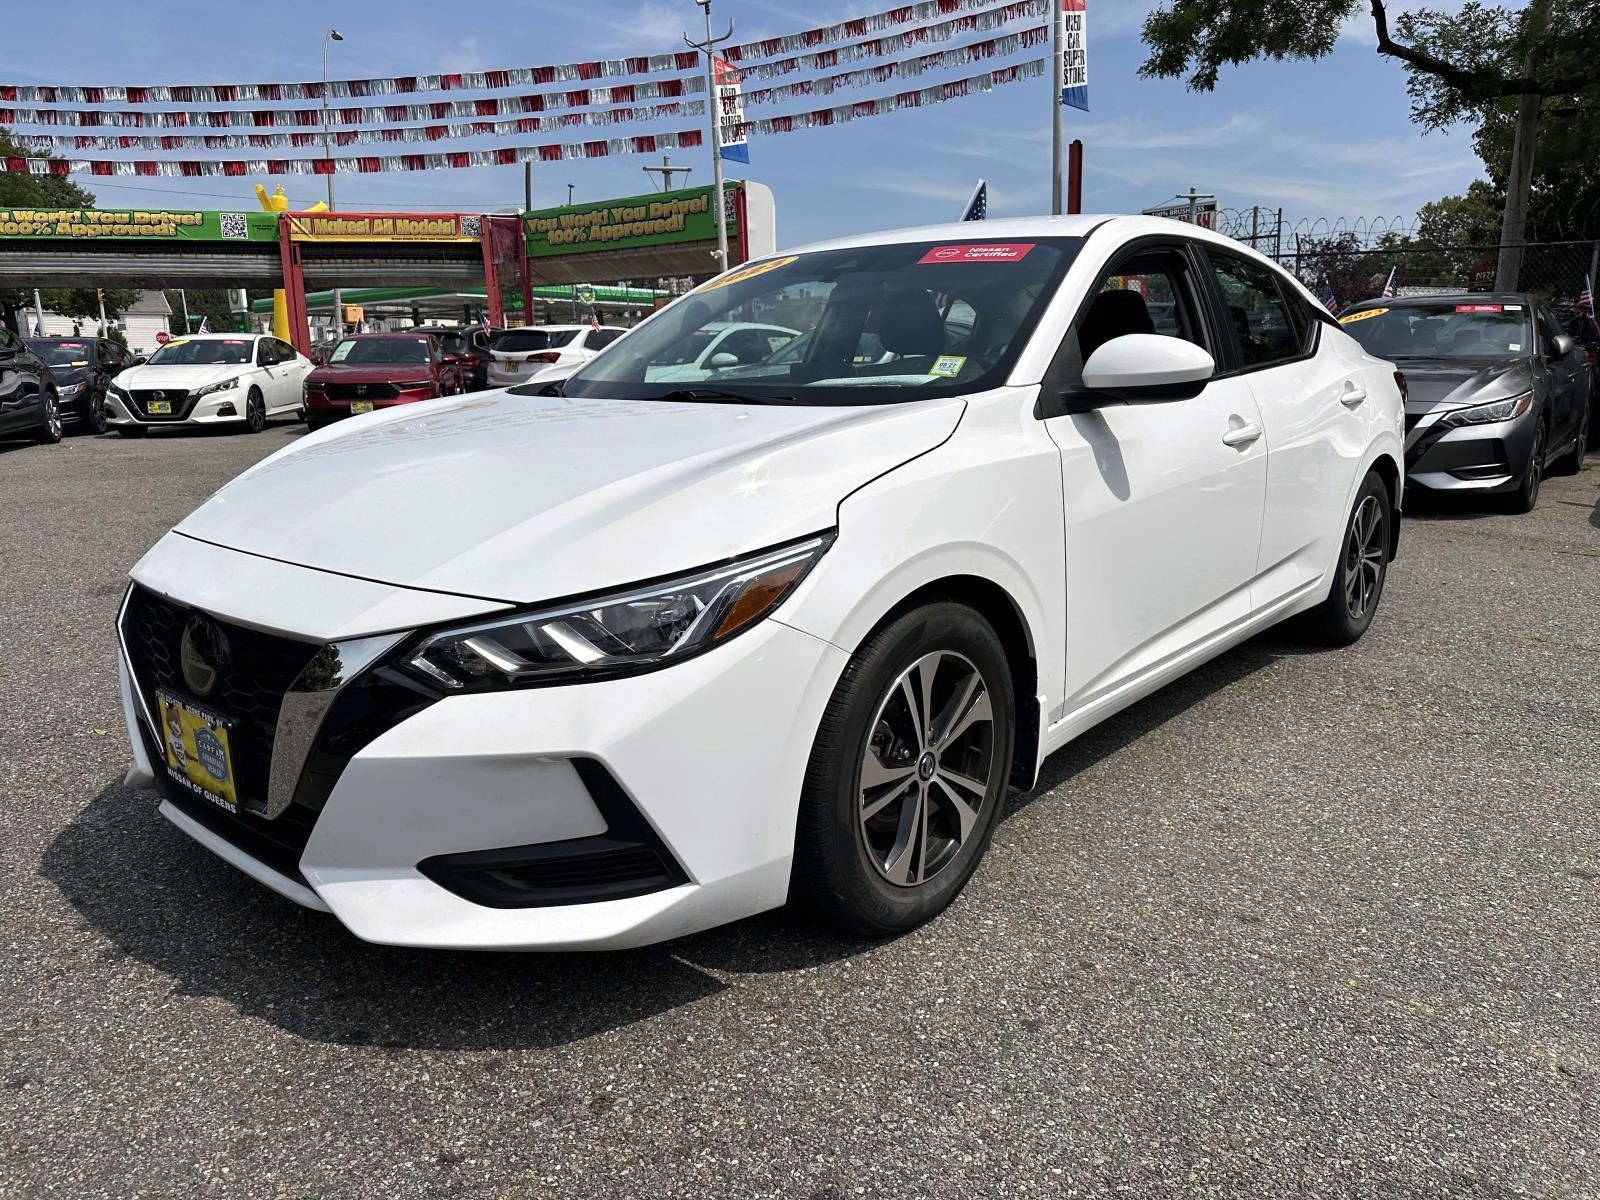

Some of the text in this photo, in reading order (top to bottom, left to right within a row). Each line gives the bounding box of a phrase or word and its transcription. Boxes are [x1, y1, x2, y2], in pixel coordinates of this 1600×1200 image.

[1065, 14, 1081, 32] USED
[1067, 32, 1080, 50] CAR
[1063, 49, 1085, 68] SUPER
[1063, 66, 1085, 86] STORE
[12, 210, 82, 223] Work!
[84, 210, 131, 224] You
[132, 211, 204, 226] Drive!
[527, 193, 709, 234] You Work! You Drive!
[55, 221, 178, 237] Approved!
[313, 217, 371, 236] Makes!
[372, 218, 395, 236] All
[395, 218, 457, 236] Models!
[548, 214, 684, 245] 100% Approved!
[155, 334, 169, 342] STOP
[167, 767, 237, 814] NISSAN OF QUEENS
